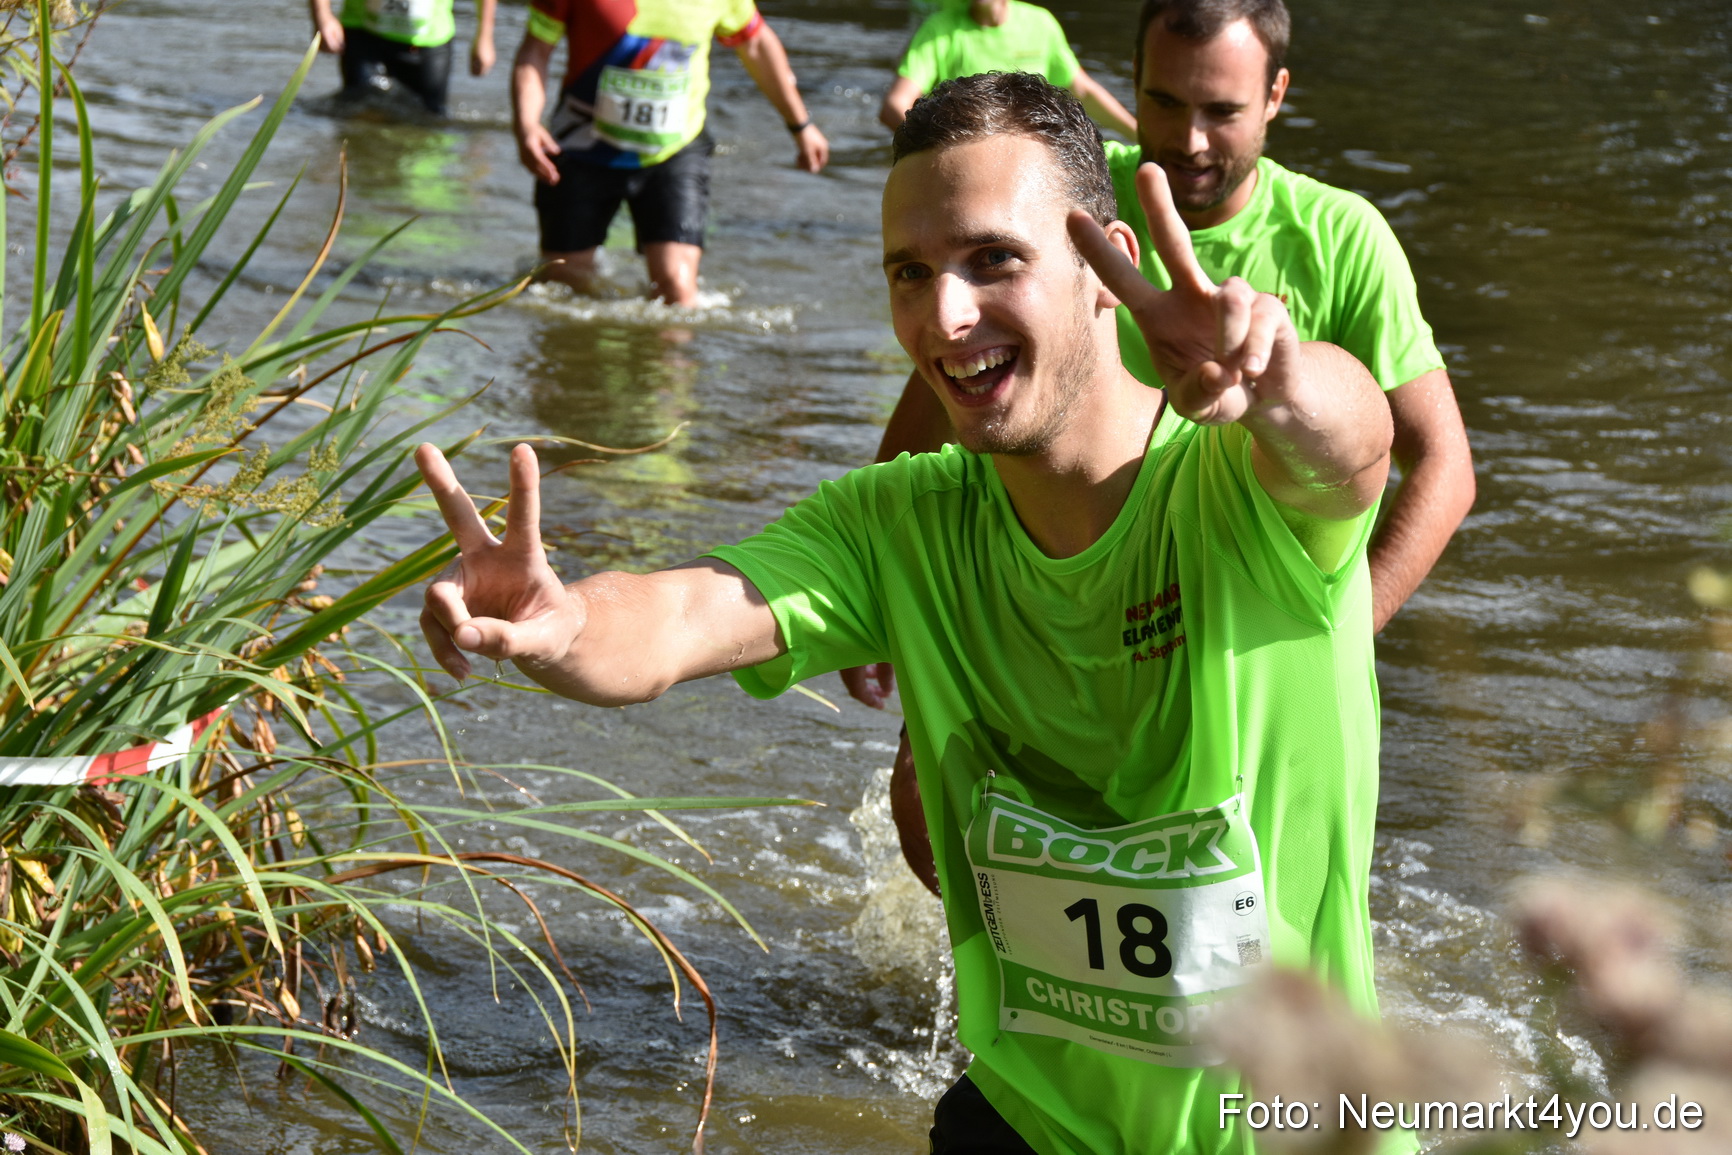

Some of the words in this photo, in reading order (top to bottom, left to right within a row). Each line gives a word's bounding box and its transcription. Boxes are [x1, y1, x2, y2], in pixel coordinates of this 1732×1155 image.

[622, 100, 668, 127] 181
[988, 807, 1238, 879] BOCK
[1235, 896, 1255, 911] E6
[1064, 898, 1172, 978] 18
[1026, 976, 1224, 1035] CHRISTOP
